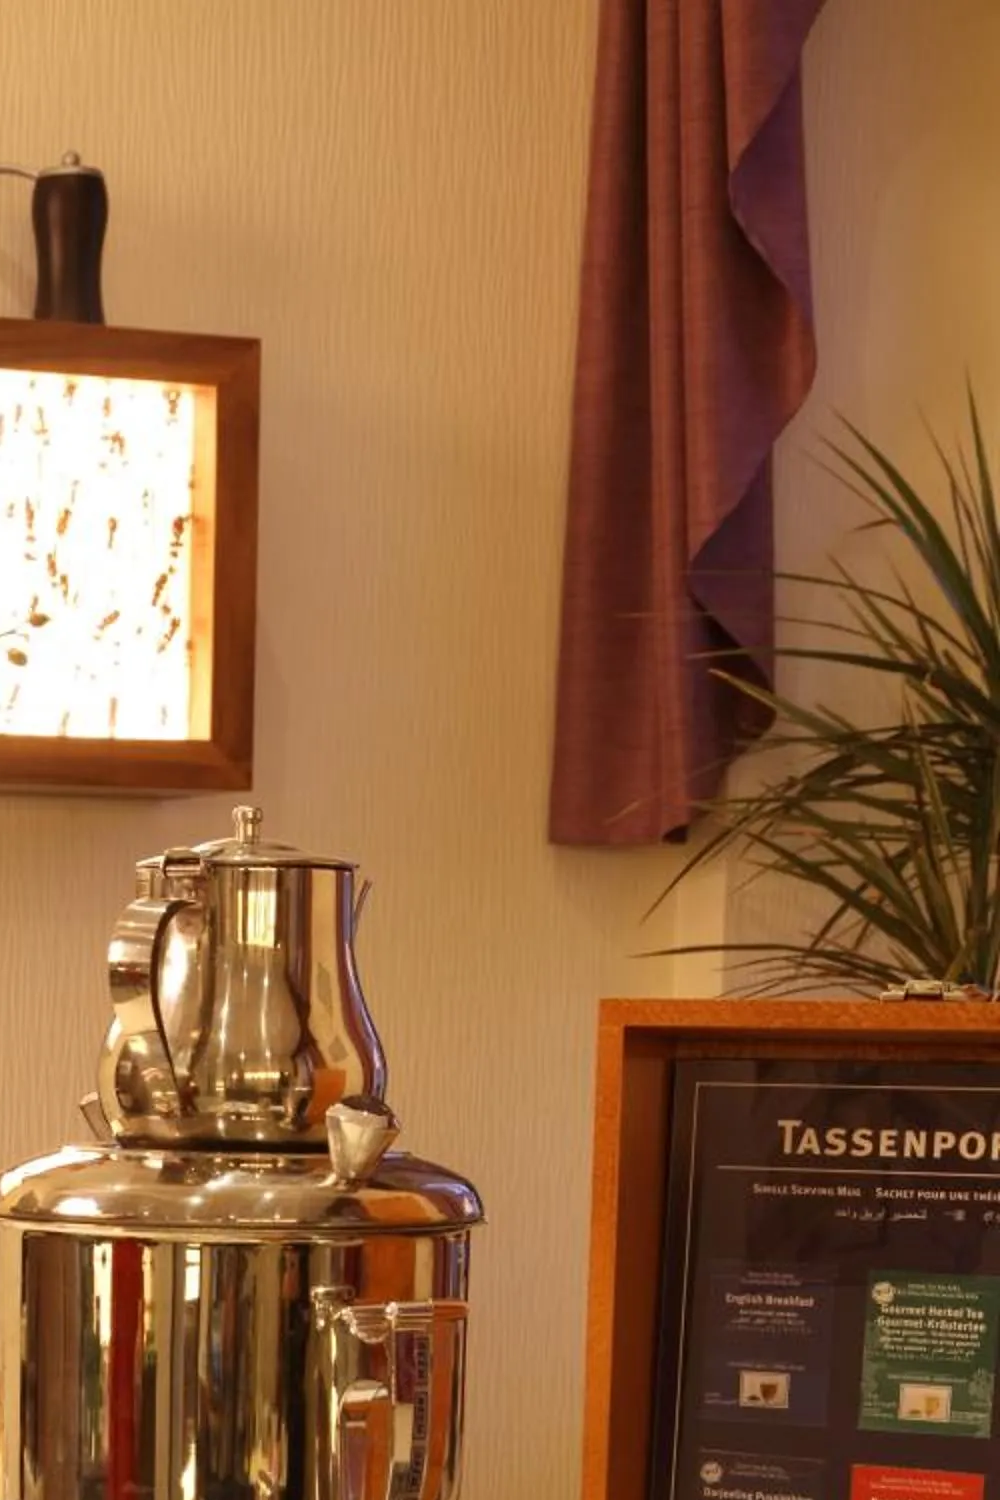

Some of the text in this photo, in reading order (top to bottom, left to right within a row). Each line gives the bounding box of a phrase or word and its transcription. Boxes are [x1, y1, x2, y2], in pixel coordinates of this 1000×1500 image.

[725, 1291, 815, 1307] English Breakfast
[928, 1305, 963, 1317] Herbal
[966, 1307, 984, 1319] Tea
